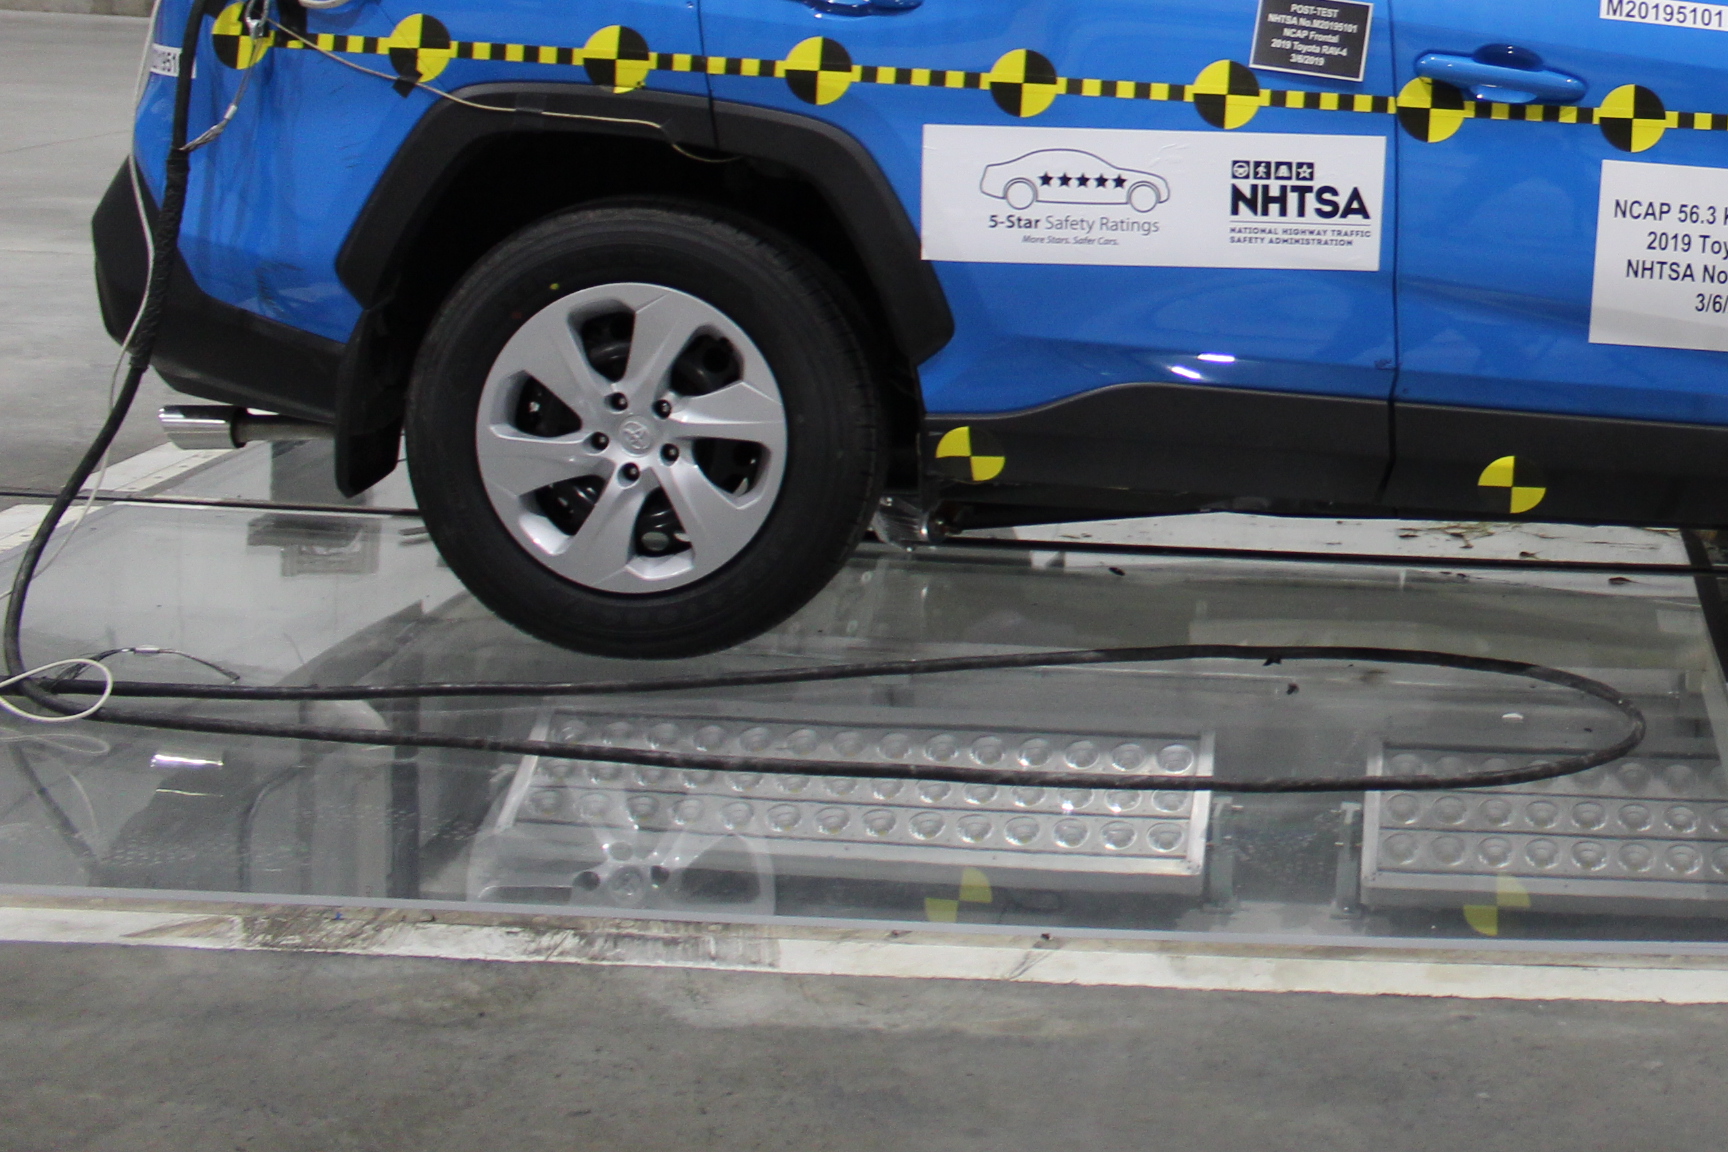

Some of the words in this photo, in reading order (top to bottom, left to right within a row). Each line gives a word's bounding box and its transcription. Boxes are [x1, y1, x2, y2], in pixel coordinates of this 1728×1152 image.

[1267, 13, 1298, 25] NHTSA
[1290, 3, 1339, 18] POST-TEST
[1283, 27, 1308, 39] NCAP
[1308, 31, 1340, 43] Frontal
[1270, 38, 1292, 49] 2019
[1292, 41, 1321, 53] Toyota
[1321, 45, 1348, 56] RAV-4
[1230, 183, 1371, 219] NHTSA
[1614, 199, 1671, 221] NCAP
[1678, 204, 1716, 225] 56.3
[988, 214, 1040, 230] 5-Star
[1044, 215, 1096, 234] Safety
[1099, 217, 1160, 236] Ratings
[1229, 227, 1278, 235] NATIONAL
[1281, 228, 1328, 236] HIGHWAY
[1331, 229, 1371, 238] TRAFFIC
[1021, 235, 1045, 244] More
[1073, 236, 1096, 245] Safer
[1229, 236, 1265, 245] SAFETY
[1268, 238, 1353, 247] ADMINISTRATION
[1646, 231, 1692, 253] 2019
[1626, 259, 1696, 283] NHTSA
